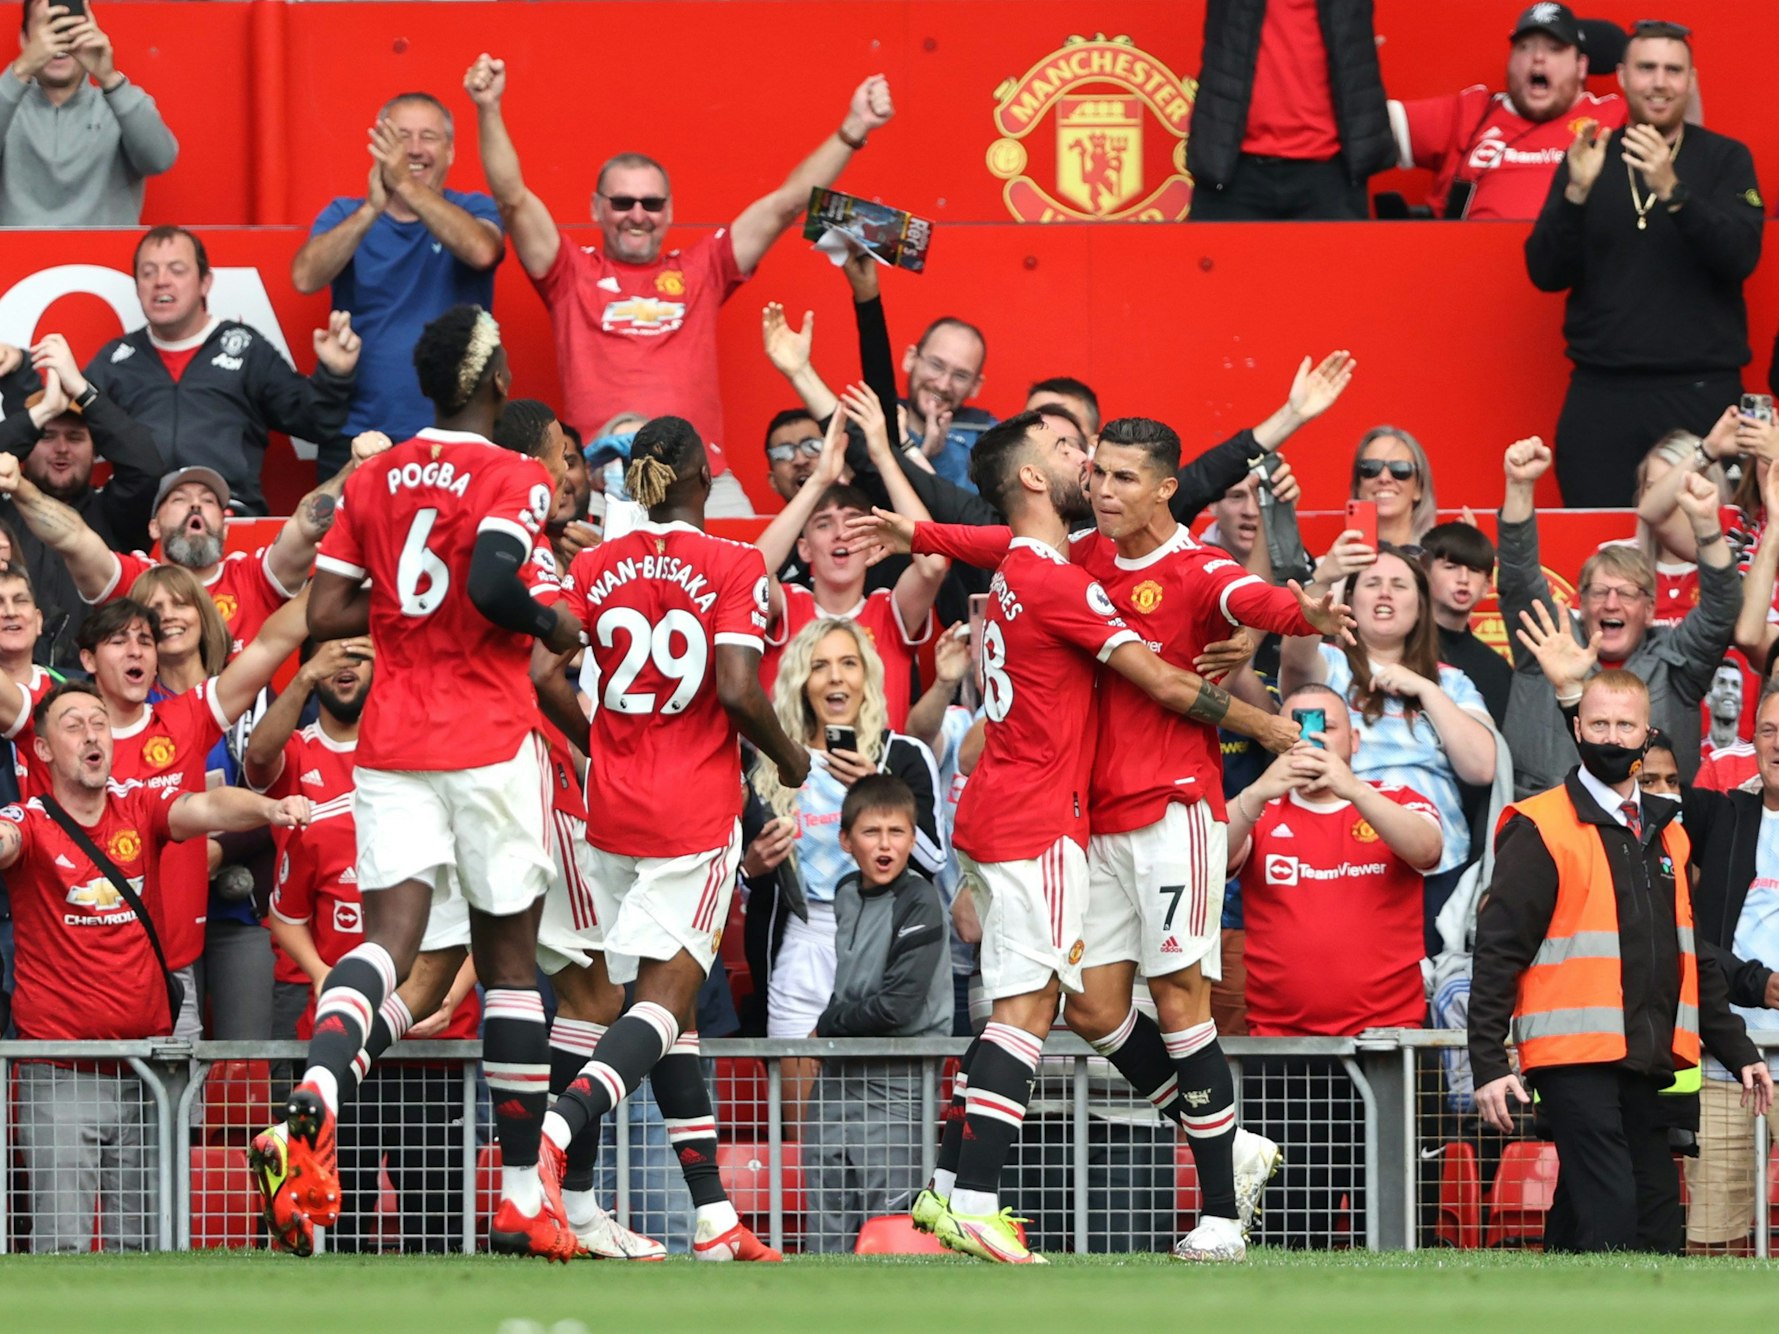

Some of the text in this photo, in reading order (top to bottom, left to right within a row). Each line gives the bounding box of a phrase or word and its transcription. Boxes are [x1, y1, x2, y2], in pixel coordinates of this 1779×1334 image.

[1009, 50, 1190, 123] MANCHESTER
[387, 462, 471, 497] POGBA
[397, 508, 449, 616] 6
[587, 555, 717, 613] WAN-BISSAKA
[596, 606, 708, 715] 29
[1298, 861, 1387, 881] TeamViewer
[1159, 885, 1186, 931] 7
